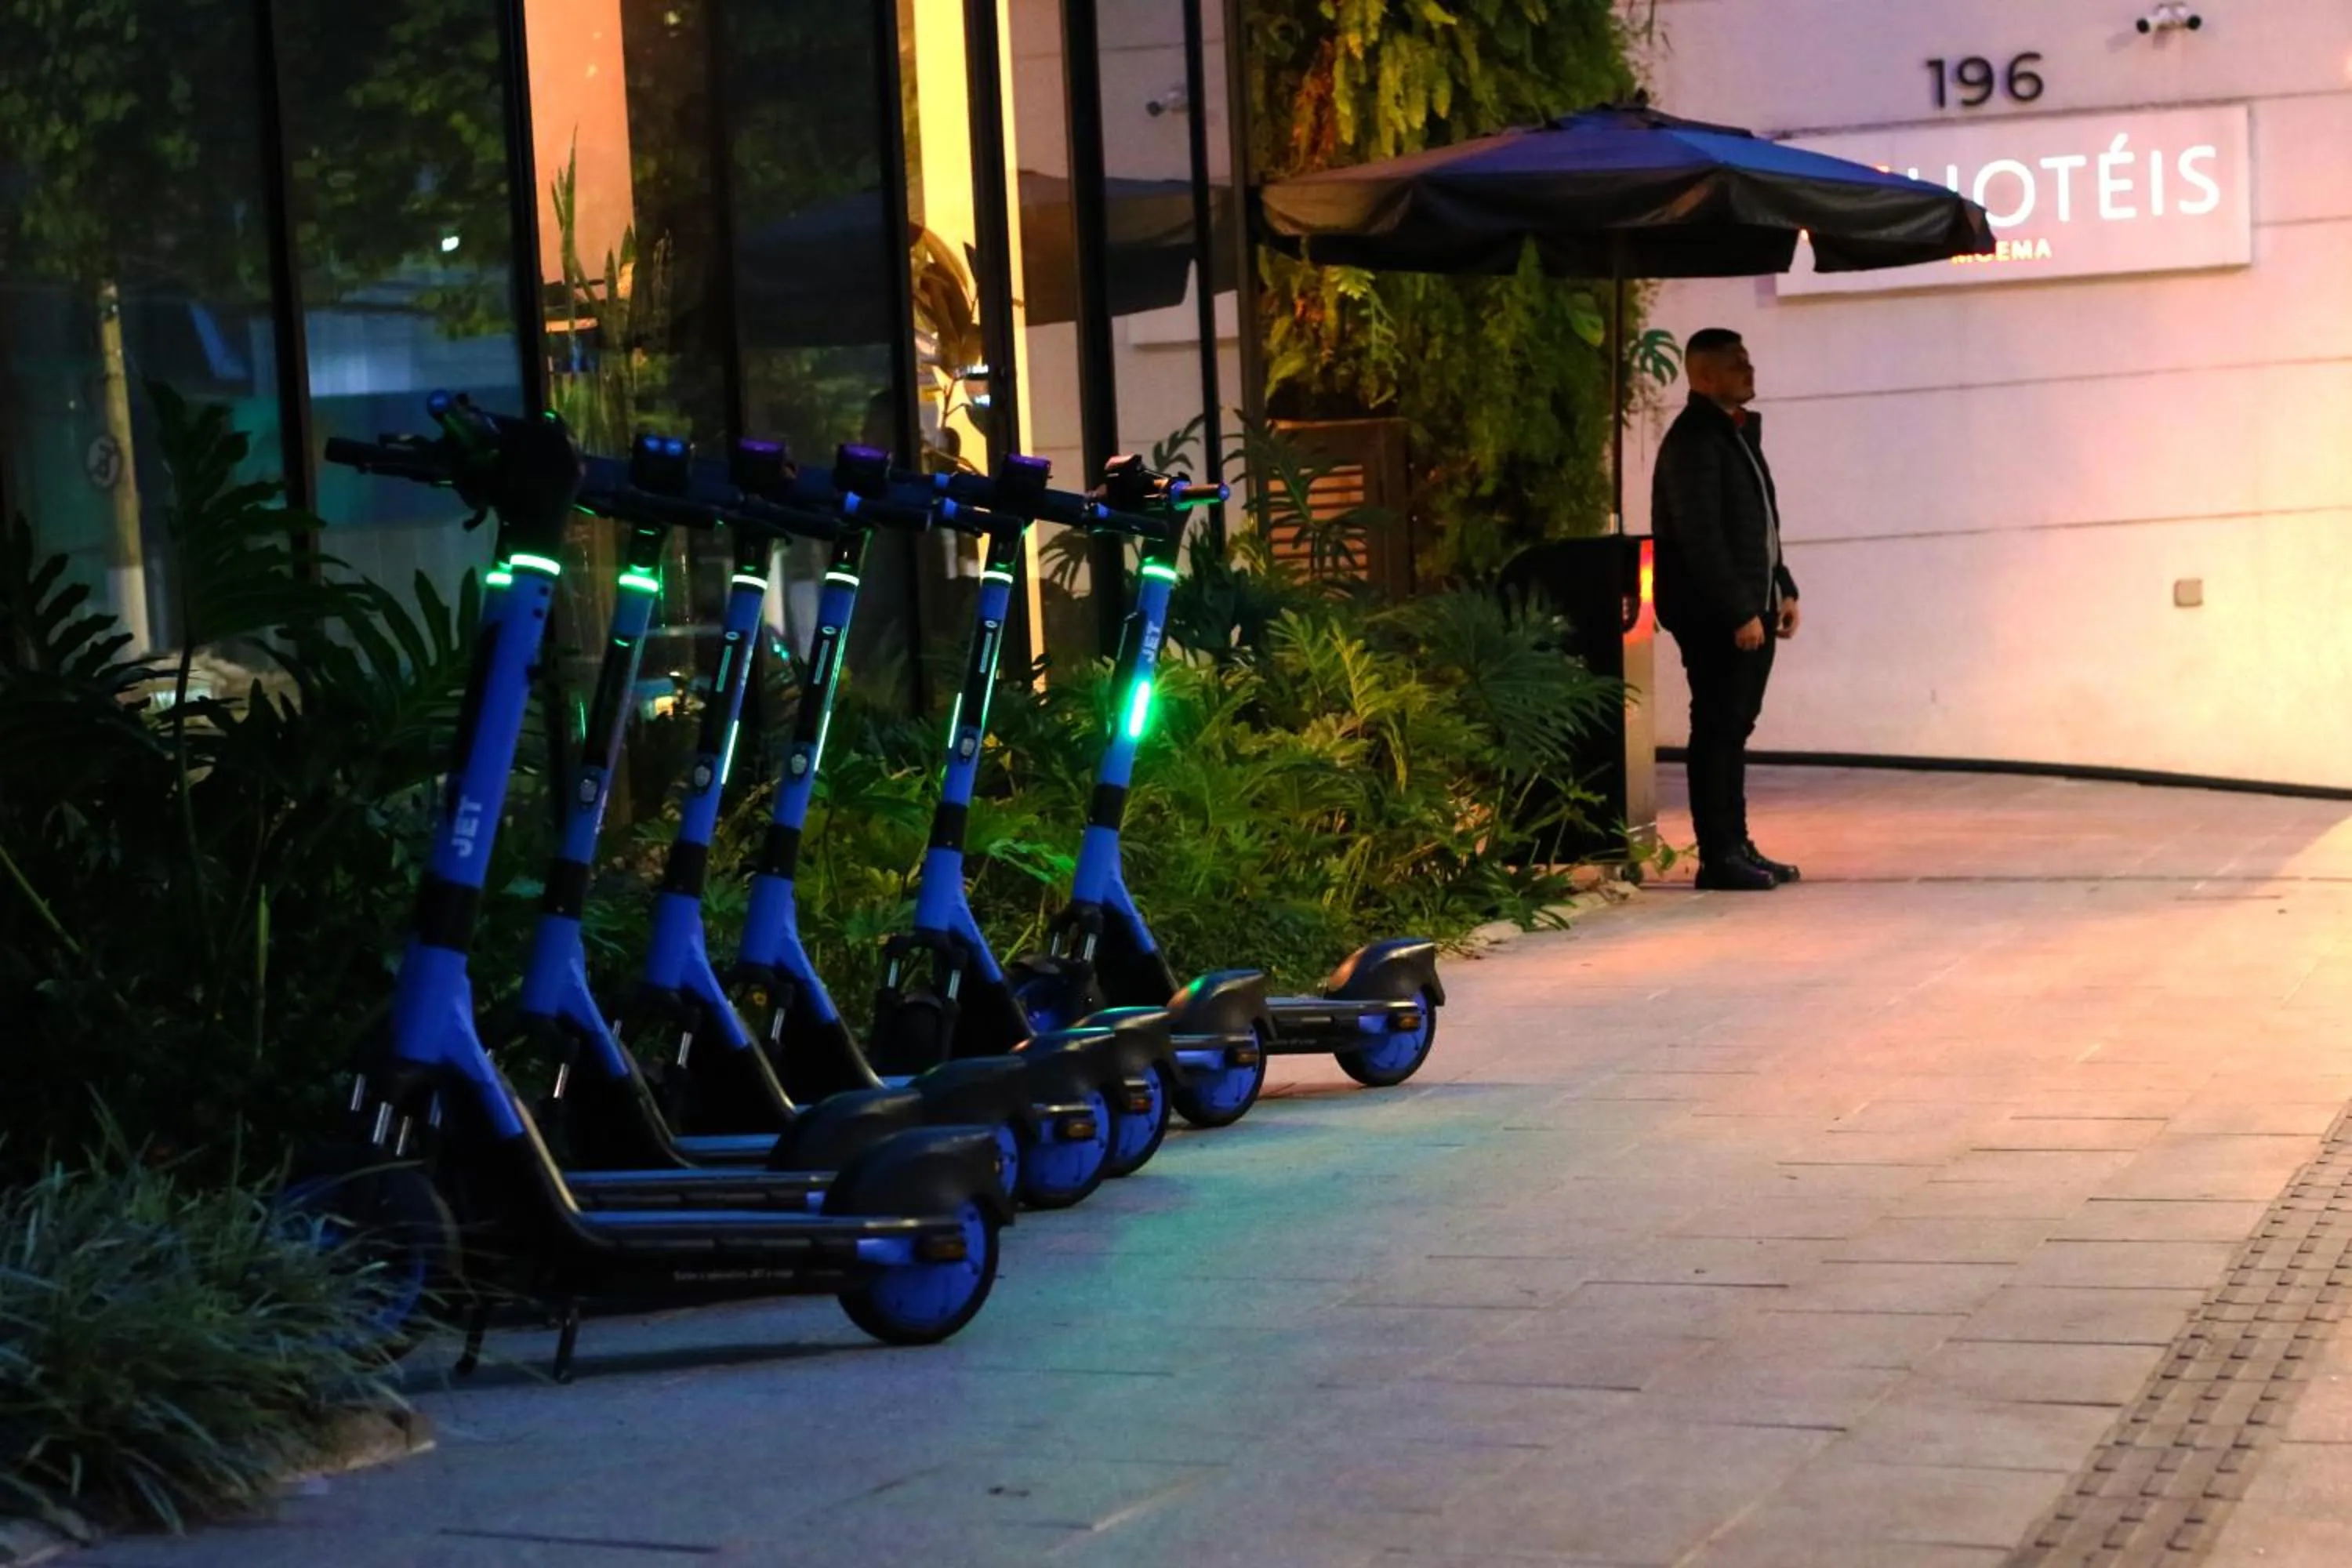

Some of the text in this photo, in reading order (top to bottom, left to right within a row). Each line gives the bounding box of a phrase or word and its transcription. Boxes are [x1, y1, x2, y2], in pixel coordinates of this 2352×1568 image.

[1926, 52, 2045, 108] 196
[1950, 238, 2052, 264] EMA
[1142, 619, 1161, 663] JET
[451, 793, 483, 858] JET
